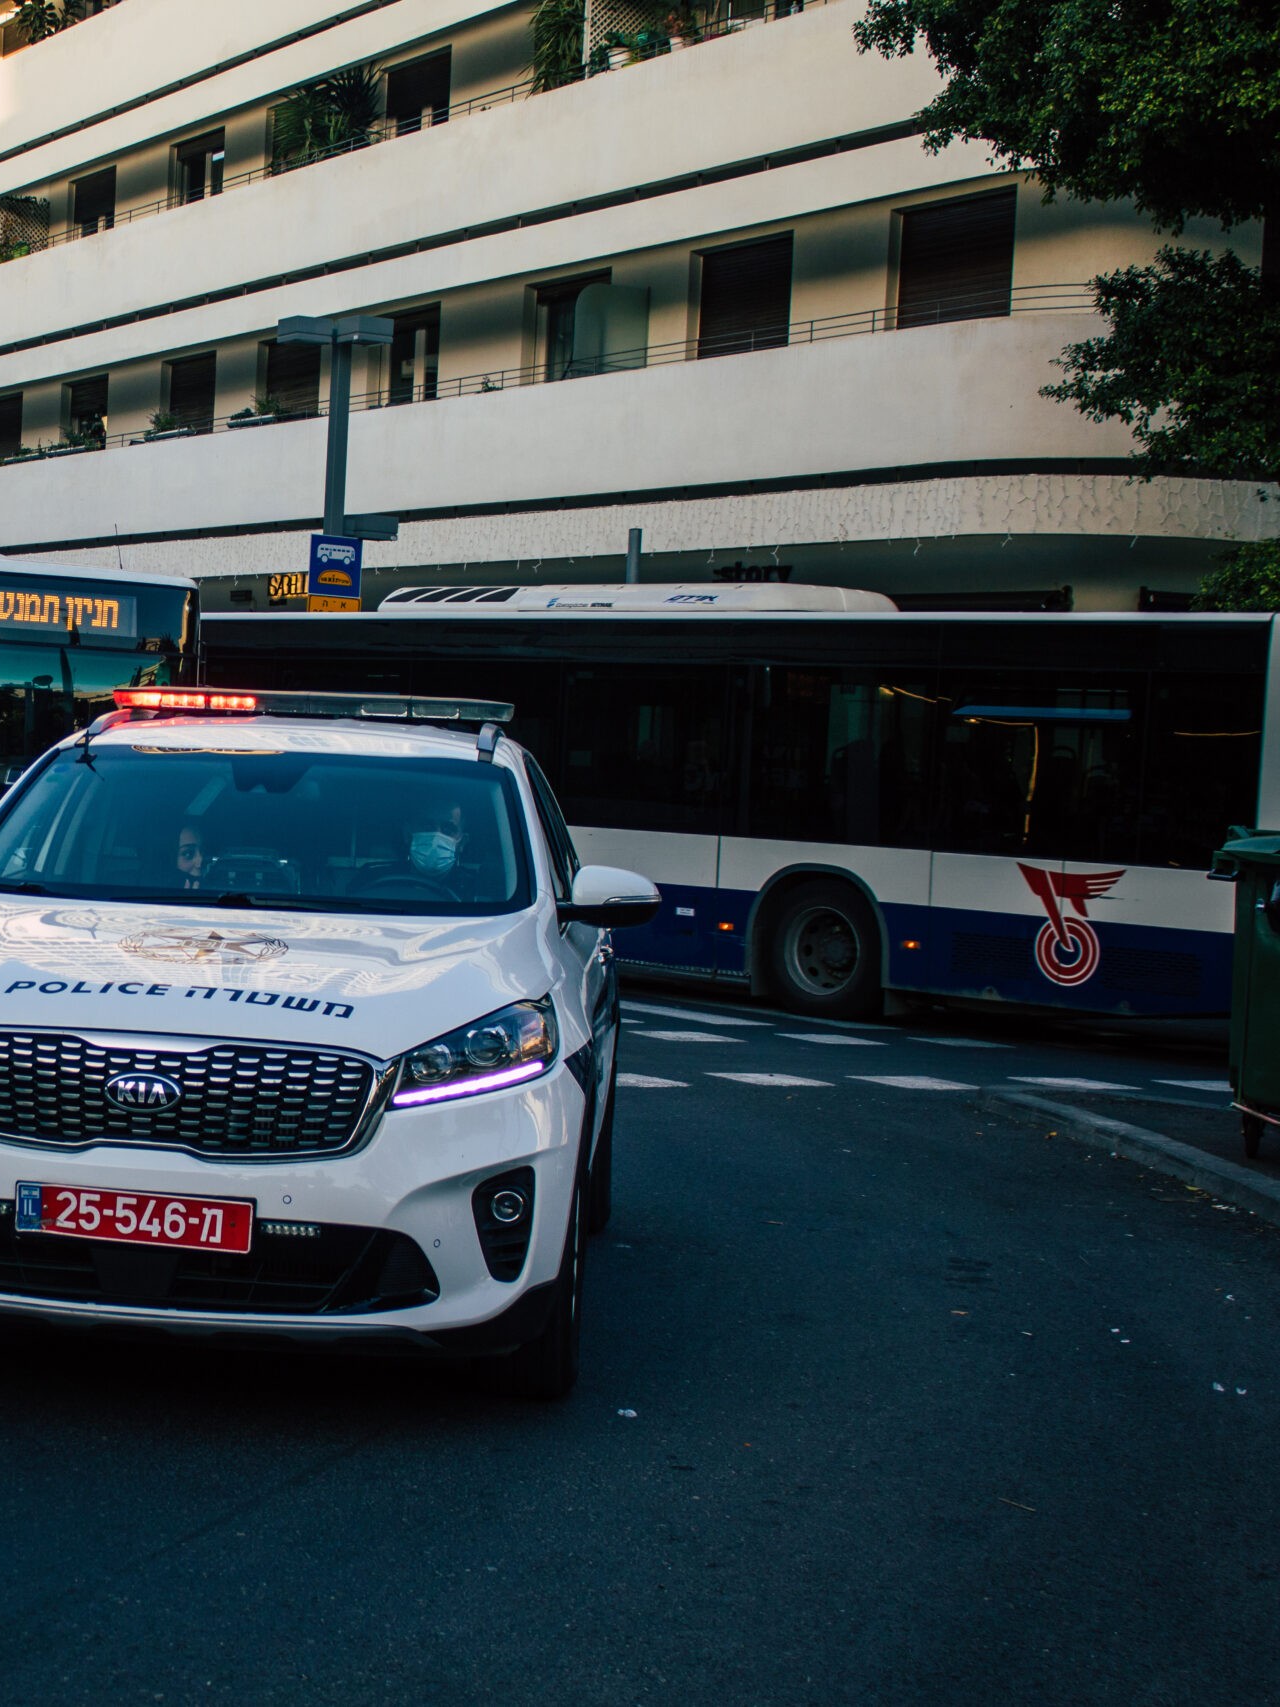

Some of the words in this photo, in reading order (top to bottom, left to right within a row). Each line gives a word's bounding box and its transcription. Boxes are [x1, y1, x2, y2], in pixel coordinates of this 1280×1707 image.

[64, 595, 120, 631] חניון
[4, 980, 172, 996] POLICE
[184, 985, 356, 1019] משטרה
[117, 1080, 168, 1105] KIA
[23, 1198, 37, 1216] IL
